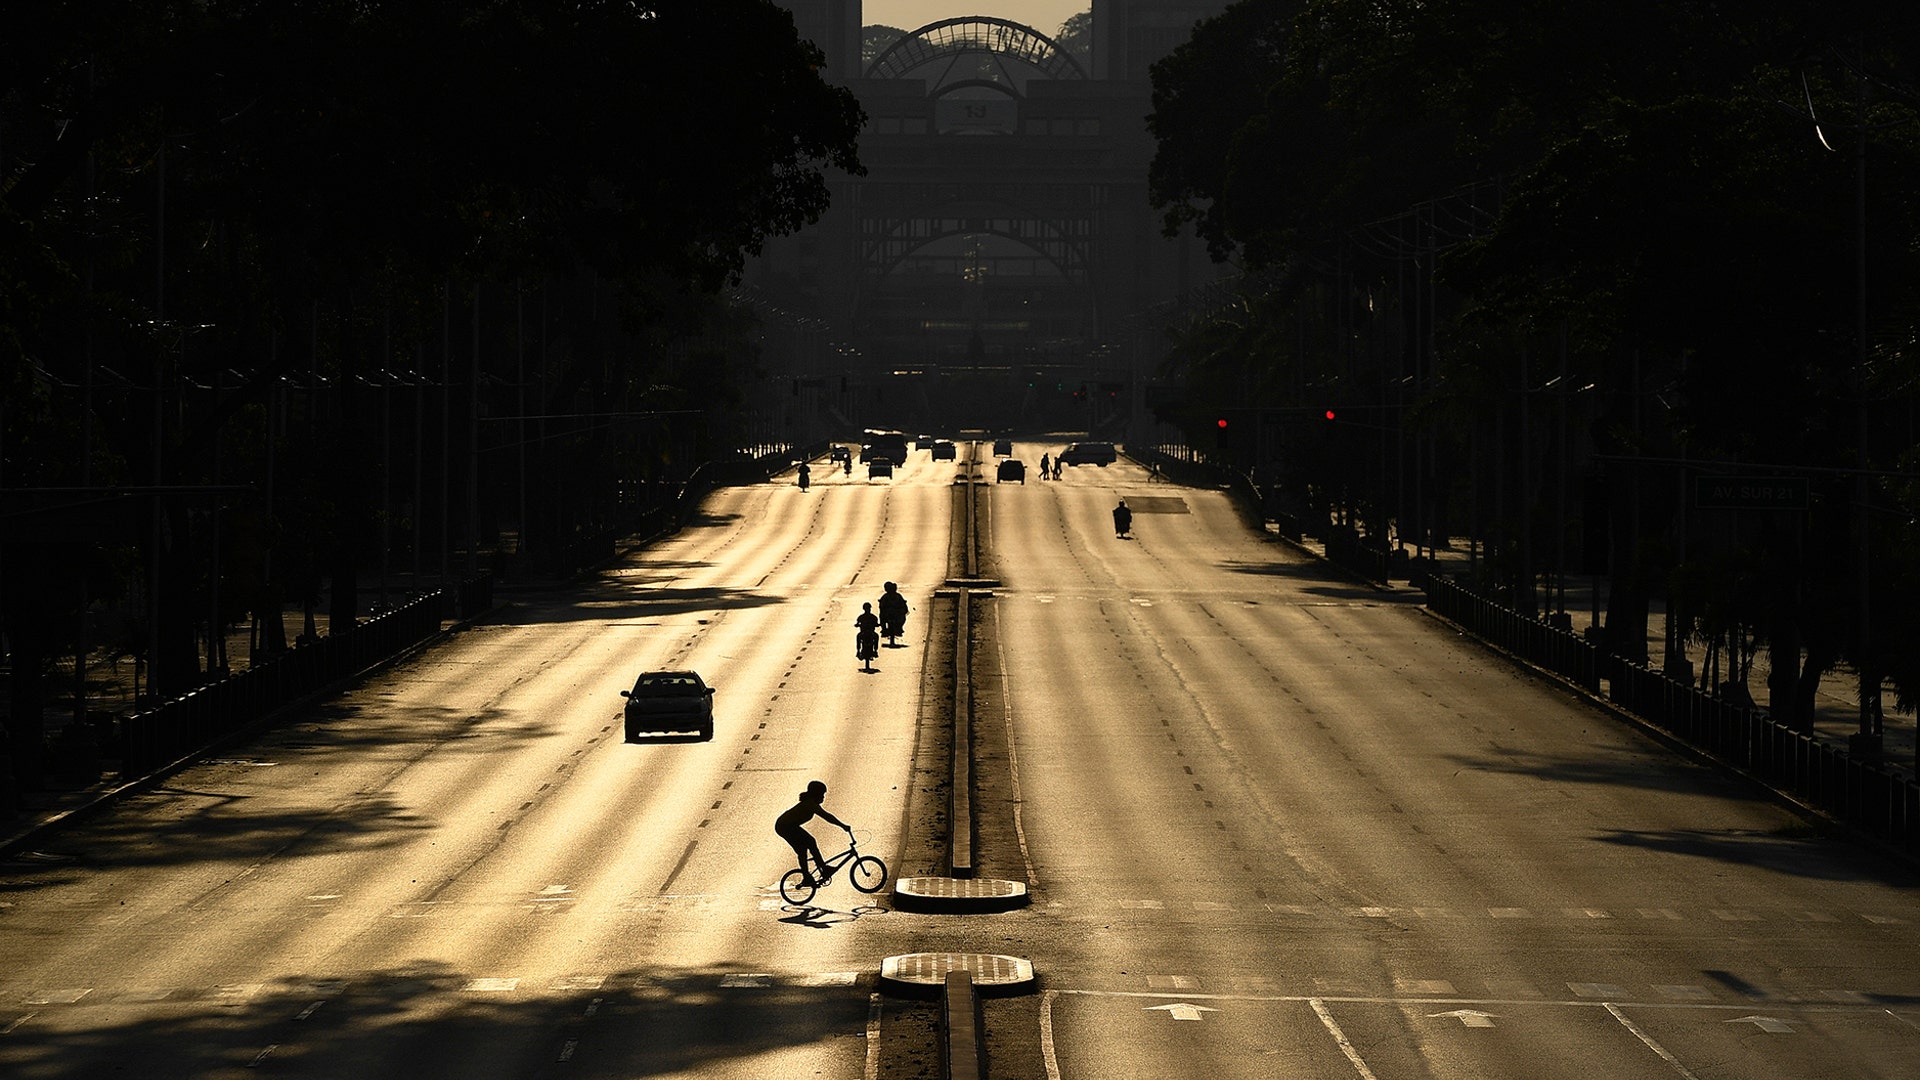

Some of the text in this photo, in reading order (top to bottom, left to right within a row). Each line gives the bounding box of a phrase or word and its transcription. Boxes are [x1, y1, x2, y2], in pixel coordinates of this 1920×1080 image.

[1712, 486, 1793, 499] AV. SUR 21
